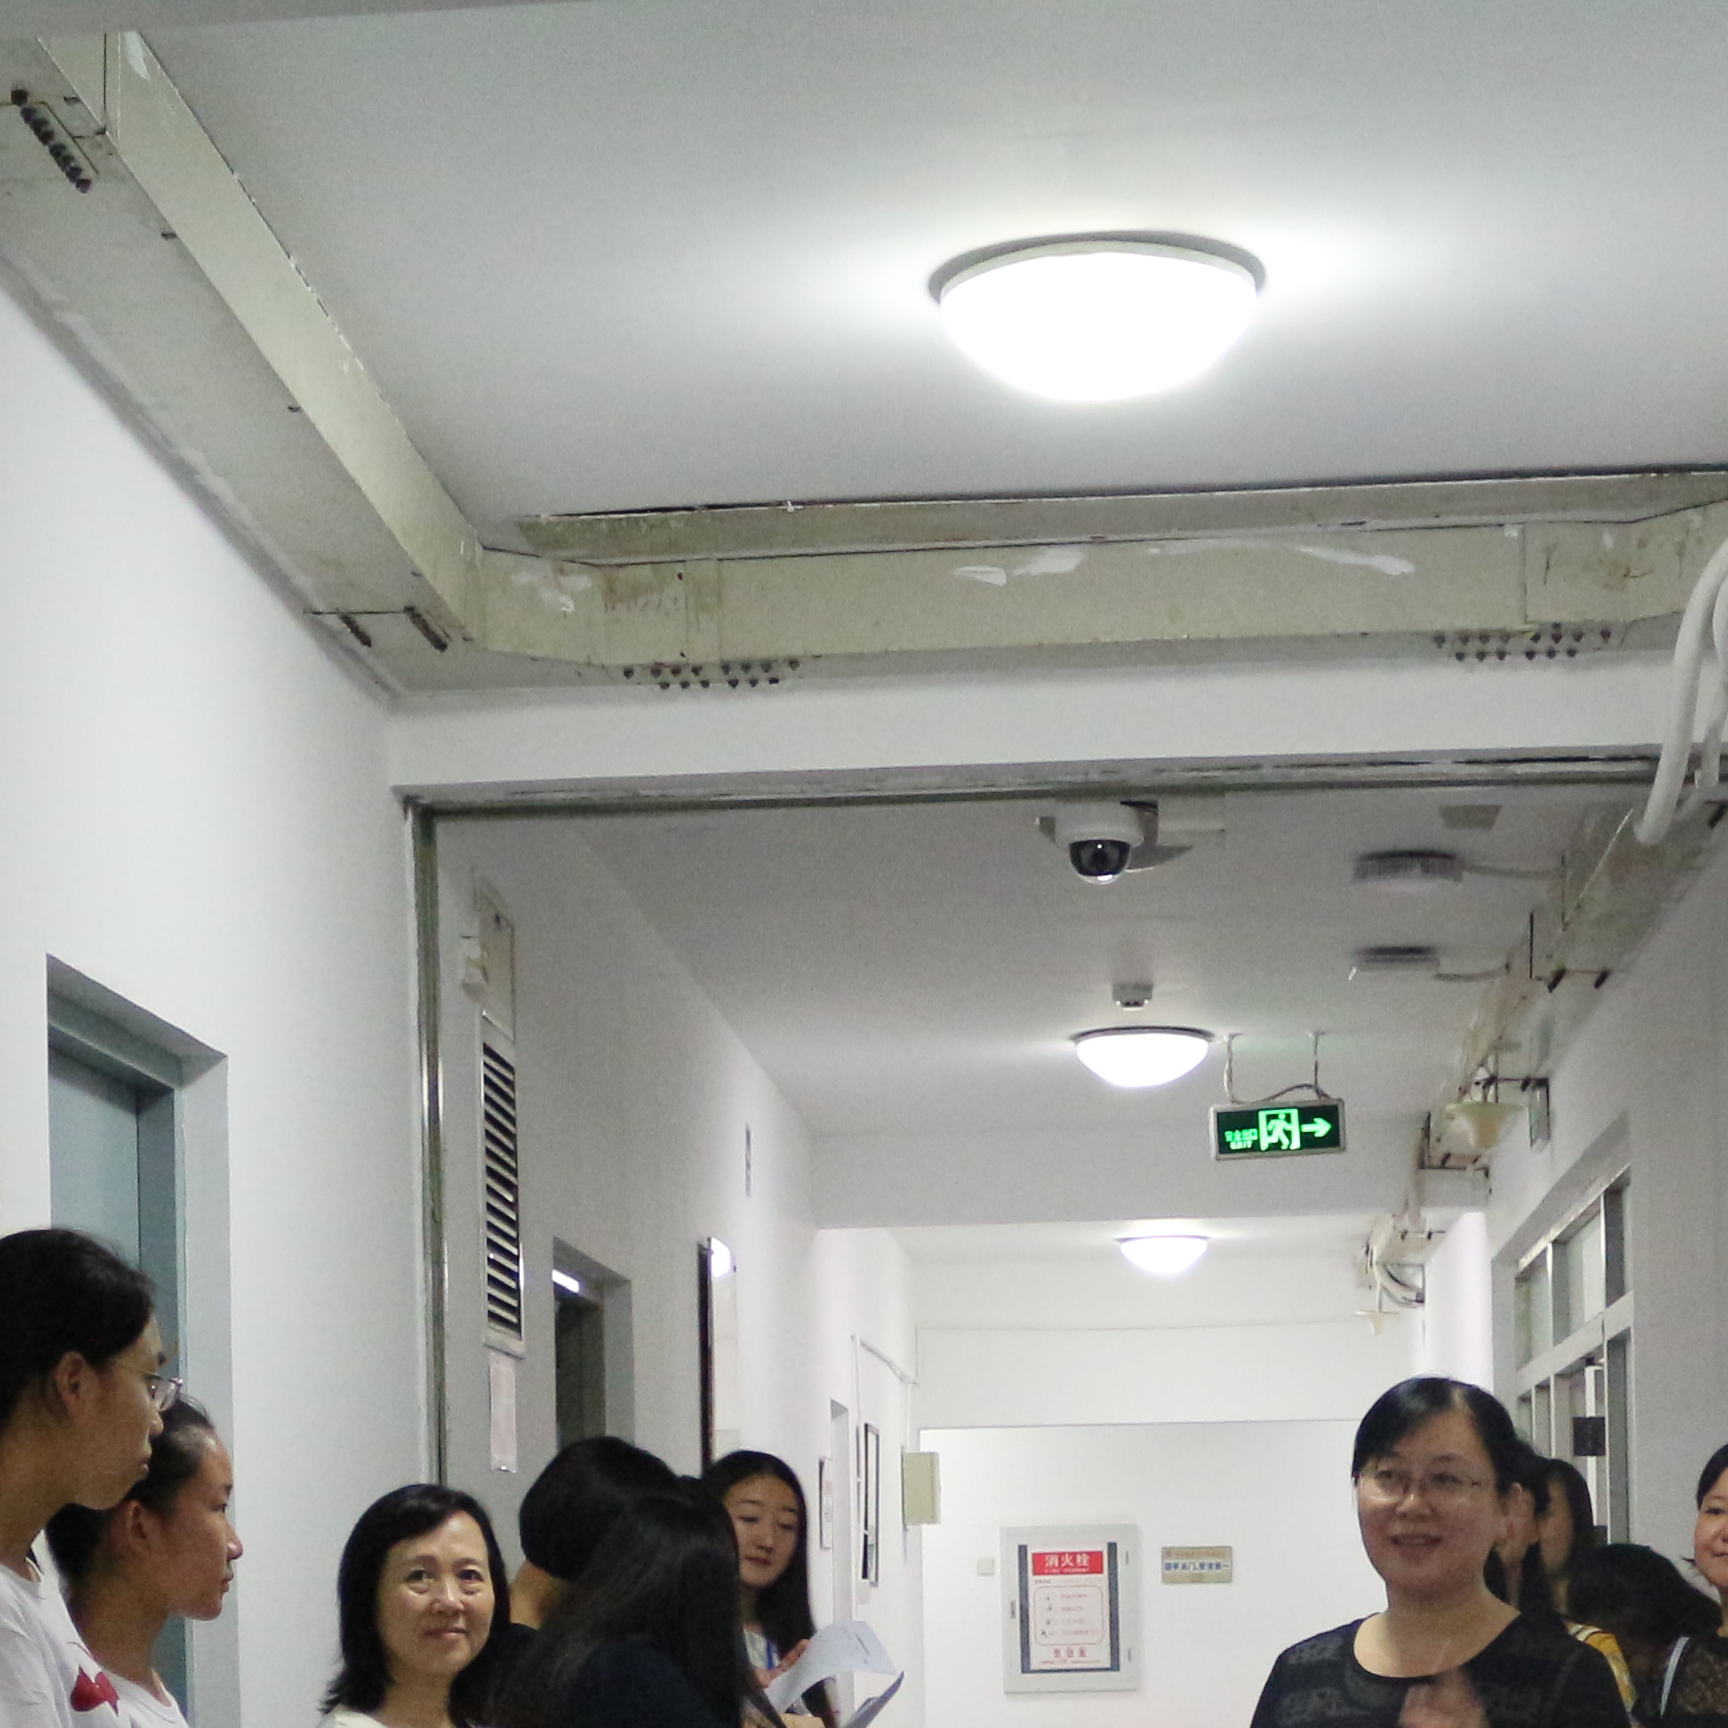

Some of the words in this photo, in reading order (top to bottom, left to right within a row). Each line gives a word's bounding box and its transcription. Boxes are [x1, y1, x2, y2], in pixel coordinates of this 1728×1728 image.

[1225, 1128, 1258, 1142] 安全出口
[1045, 1554, 1091, 1567] 消火栓
